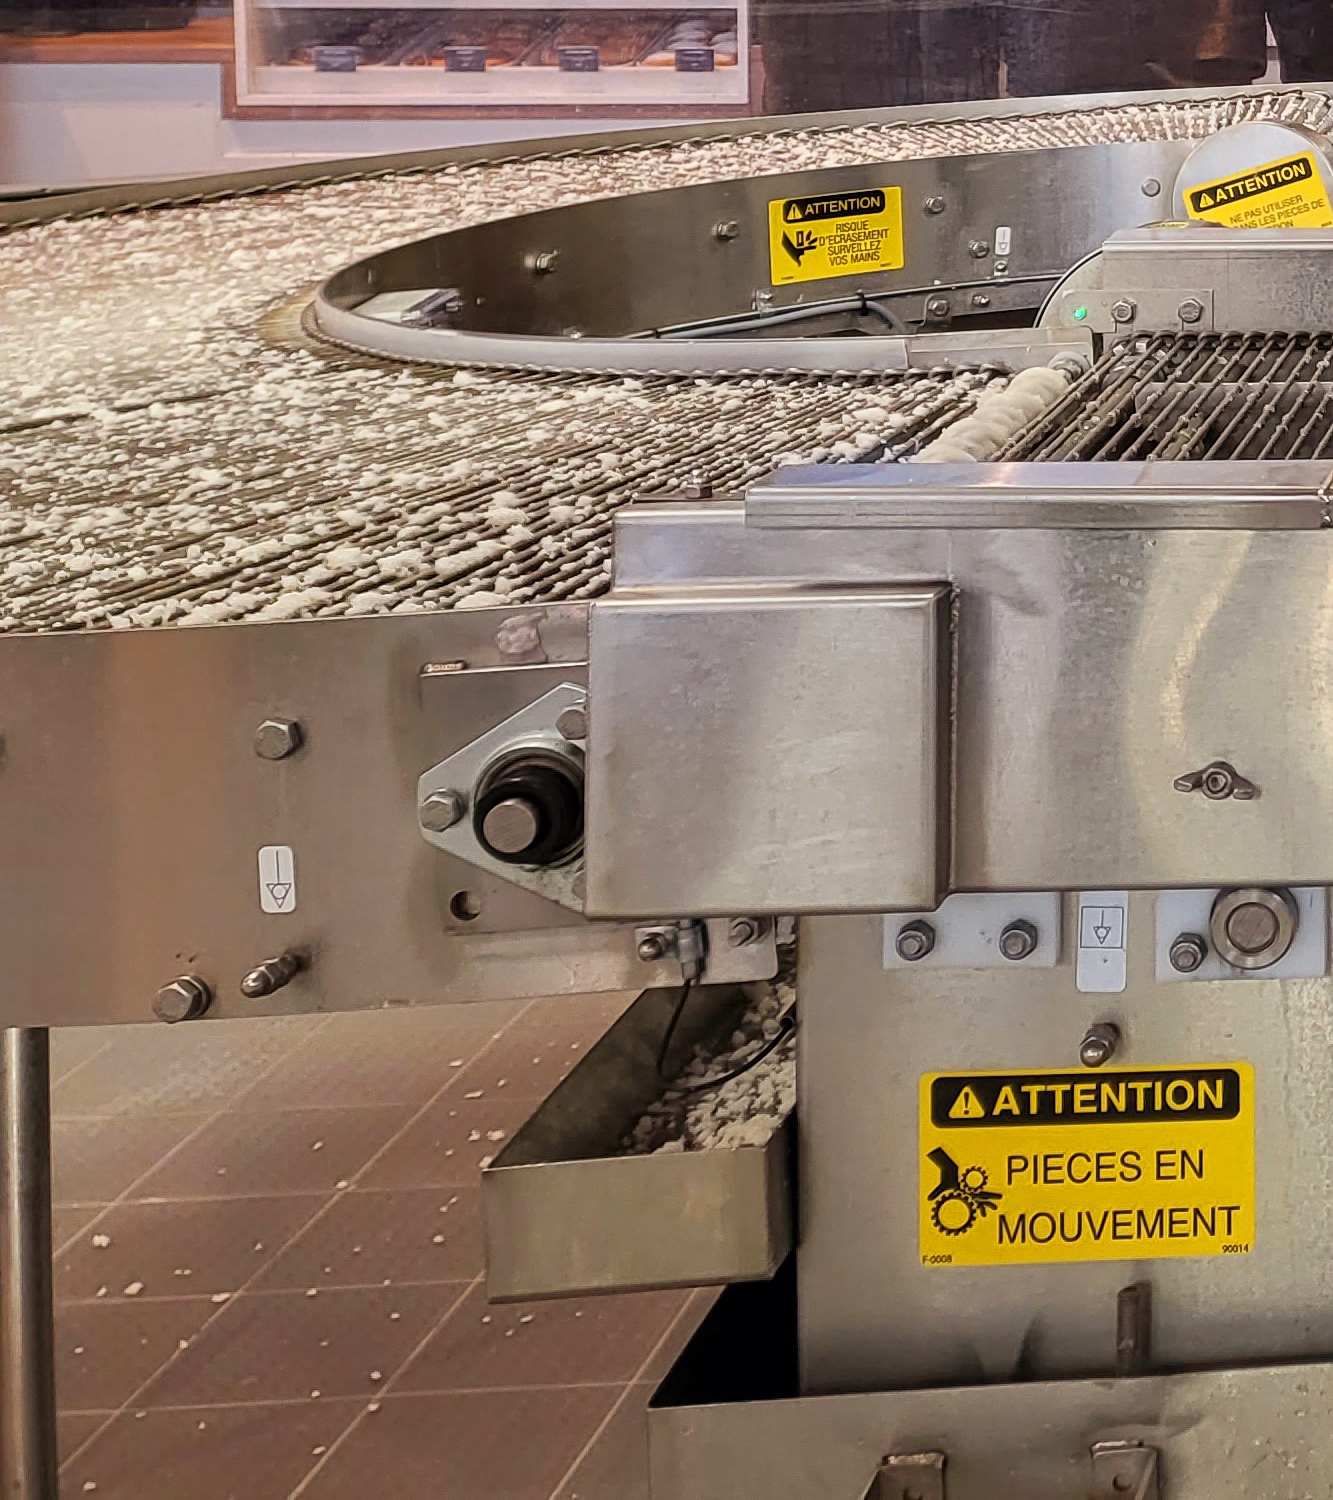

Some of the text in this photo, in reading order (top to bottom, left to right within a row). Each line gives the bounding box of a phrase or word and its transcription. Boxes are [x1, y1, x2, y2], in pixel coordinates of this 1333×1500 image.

[1216, 162, 1306, 202] ATTENTION
[805, 195, 881, 216] ATTENTION
[1230, 194, 1303, 224] NE PAS UTILISER
[1258, 215, 1277, 226] LES
[1278, 204, 1311, 222] PIECES
[1312, 199, 1326, 209] DE
[818, 228, 890, 247] D'ECRASEMENT
[835, 220, 870, 233] RISQUE
[827, 240, 882, 256] SURVEILLEZ
[829, 251, 880, 266] VOS MAINS
[992, 1079, 1225, 1116] ATTENTION
[1007, 1148, 1204, 1186] PIECES EN
[997, 1206, 1241, 1245] MOUVEMENT
[1221, 1244, 1249, 1254] 90014
